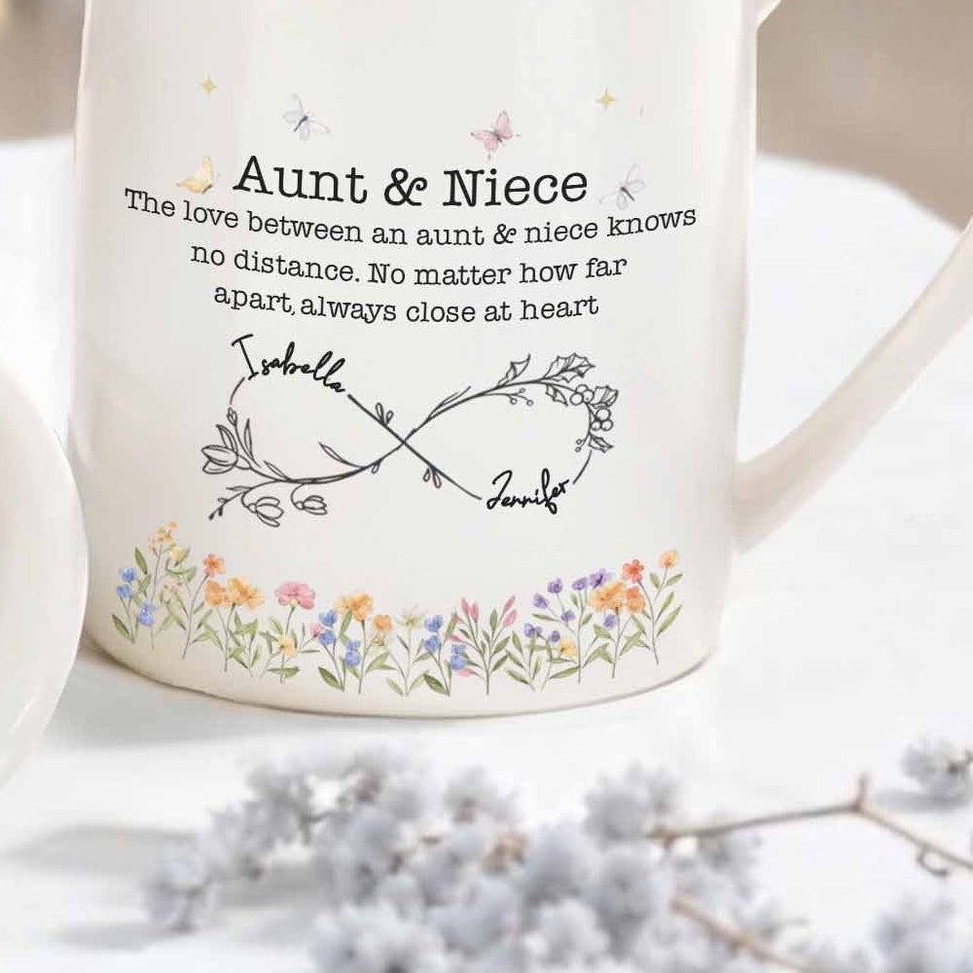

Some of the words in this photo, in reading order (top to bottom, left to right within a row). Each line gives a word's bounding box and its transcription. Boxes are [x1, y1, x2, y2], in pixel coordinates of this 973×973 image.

[231, 155, 368, 204] Aunt
[383, 167, 428, 207] &
[442, 168, 588, 208] Niece
[124, 187, 176, 218] The
[182, 199, 239, 229] love
[246, 209, 364, 243] between
[371, 227, 408, 246] an
[416, 225, 485, 246] aunt
[493, 223, 517, 245] &
[524, 221, 599, 244] niece
[606, 208, 697, 237] knows
[190, 245, 226, 267] no
[233, 249, 360, 283] distance.
[367, 262, 406, 285] No
[413, 265, 512, 286] matter
[519, 262, 579, 284] how
[585, 257, 628, 279] far
[214, 286, 297, 317] apart,
[300, 297, 397, 325] always
[406, 301, 476, 323] close
[483, 301, 513, 323] at
[519, 295, 599, 321] heart
[230, 333, 346, 393] Isabella
[486, 467, 570, 515] Jennifer
